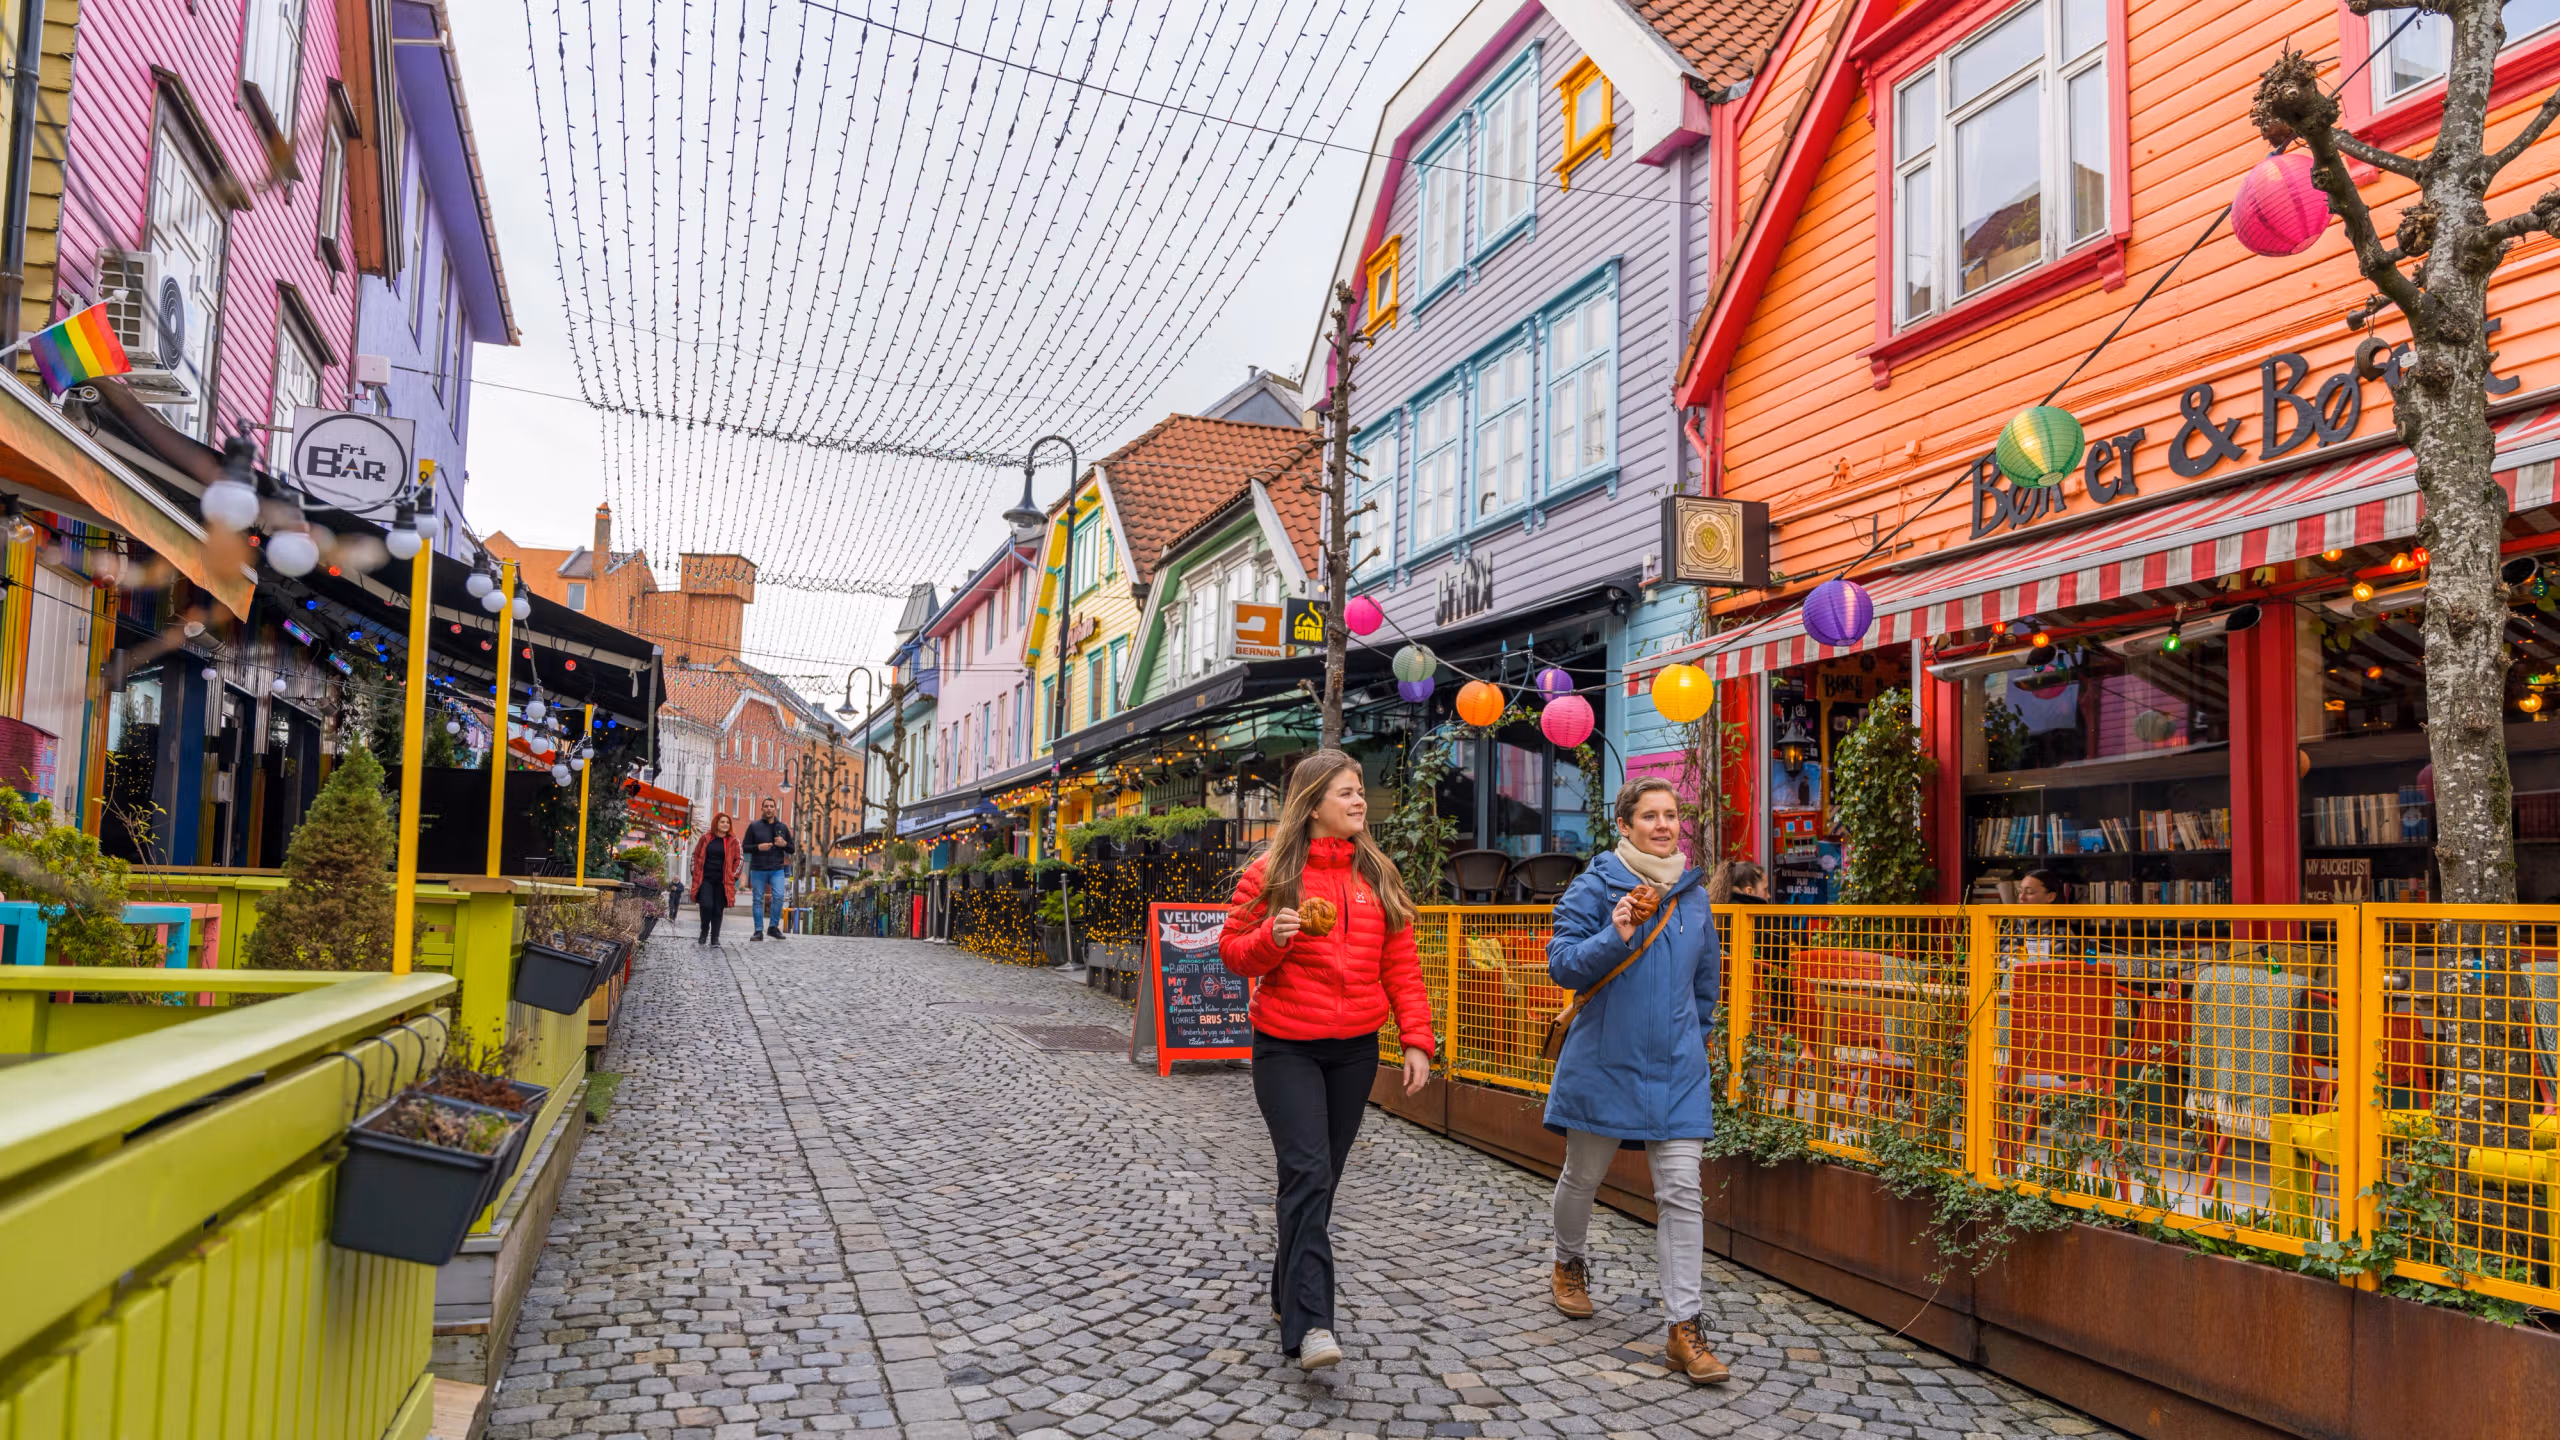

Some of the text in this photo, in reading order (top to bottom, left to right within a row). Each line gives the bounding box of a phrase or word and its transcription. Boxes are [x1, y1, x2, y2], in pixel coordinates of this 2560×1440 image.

[2168, 382, 2247, 478] &
[340, 443, 367, 456] Fri
[307, 446, 386, 482] BAR
[1235, 646, 1281, 657] BERNINA
[2307, 860, 2369, 876] MY BUCKET LIST
[1164, 912, 1228, 923] VELKOMM
[1181, 923, 1201, 933] TIL
[1169, 963, 1226, 974] BARISTA KAFFE
[1168, 977, 1187, 987] MAT
[1220, 977, 1242, 986] Byens
[1173, 987, 1183, 996] og
[1171, 995, 1202, 1006] SNACKS
[1172, 1016, 1196, 1025] LOKALE
[1199, 1014, 1222, 1025] BRUS
[1228, 1013, 1246, 1023] JUS
